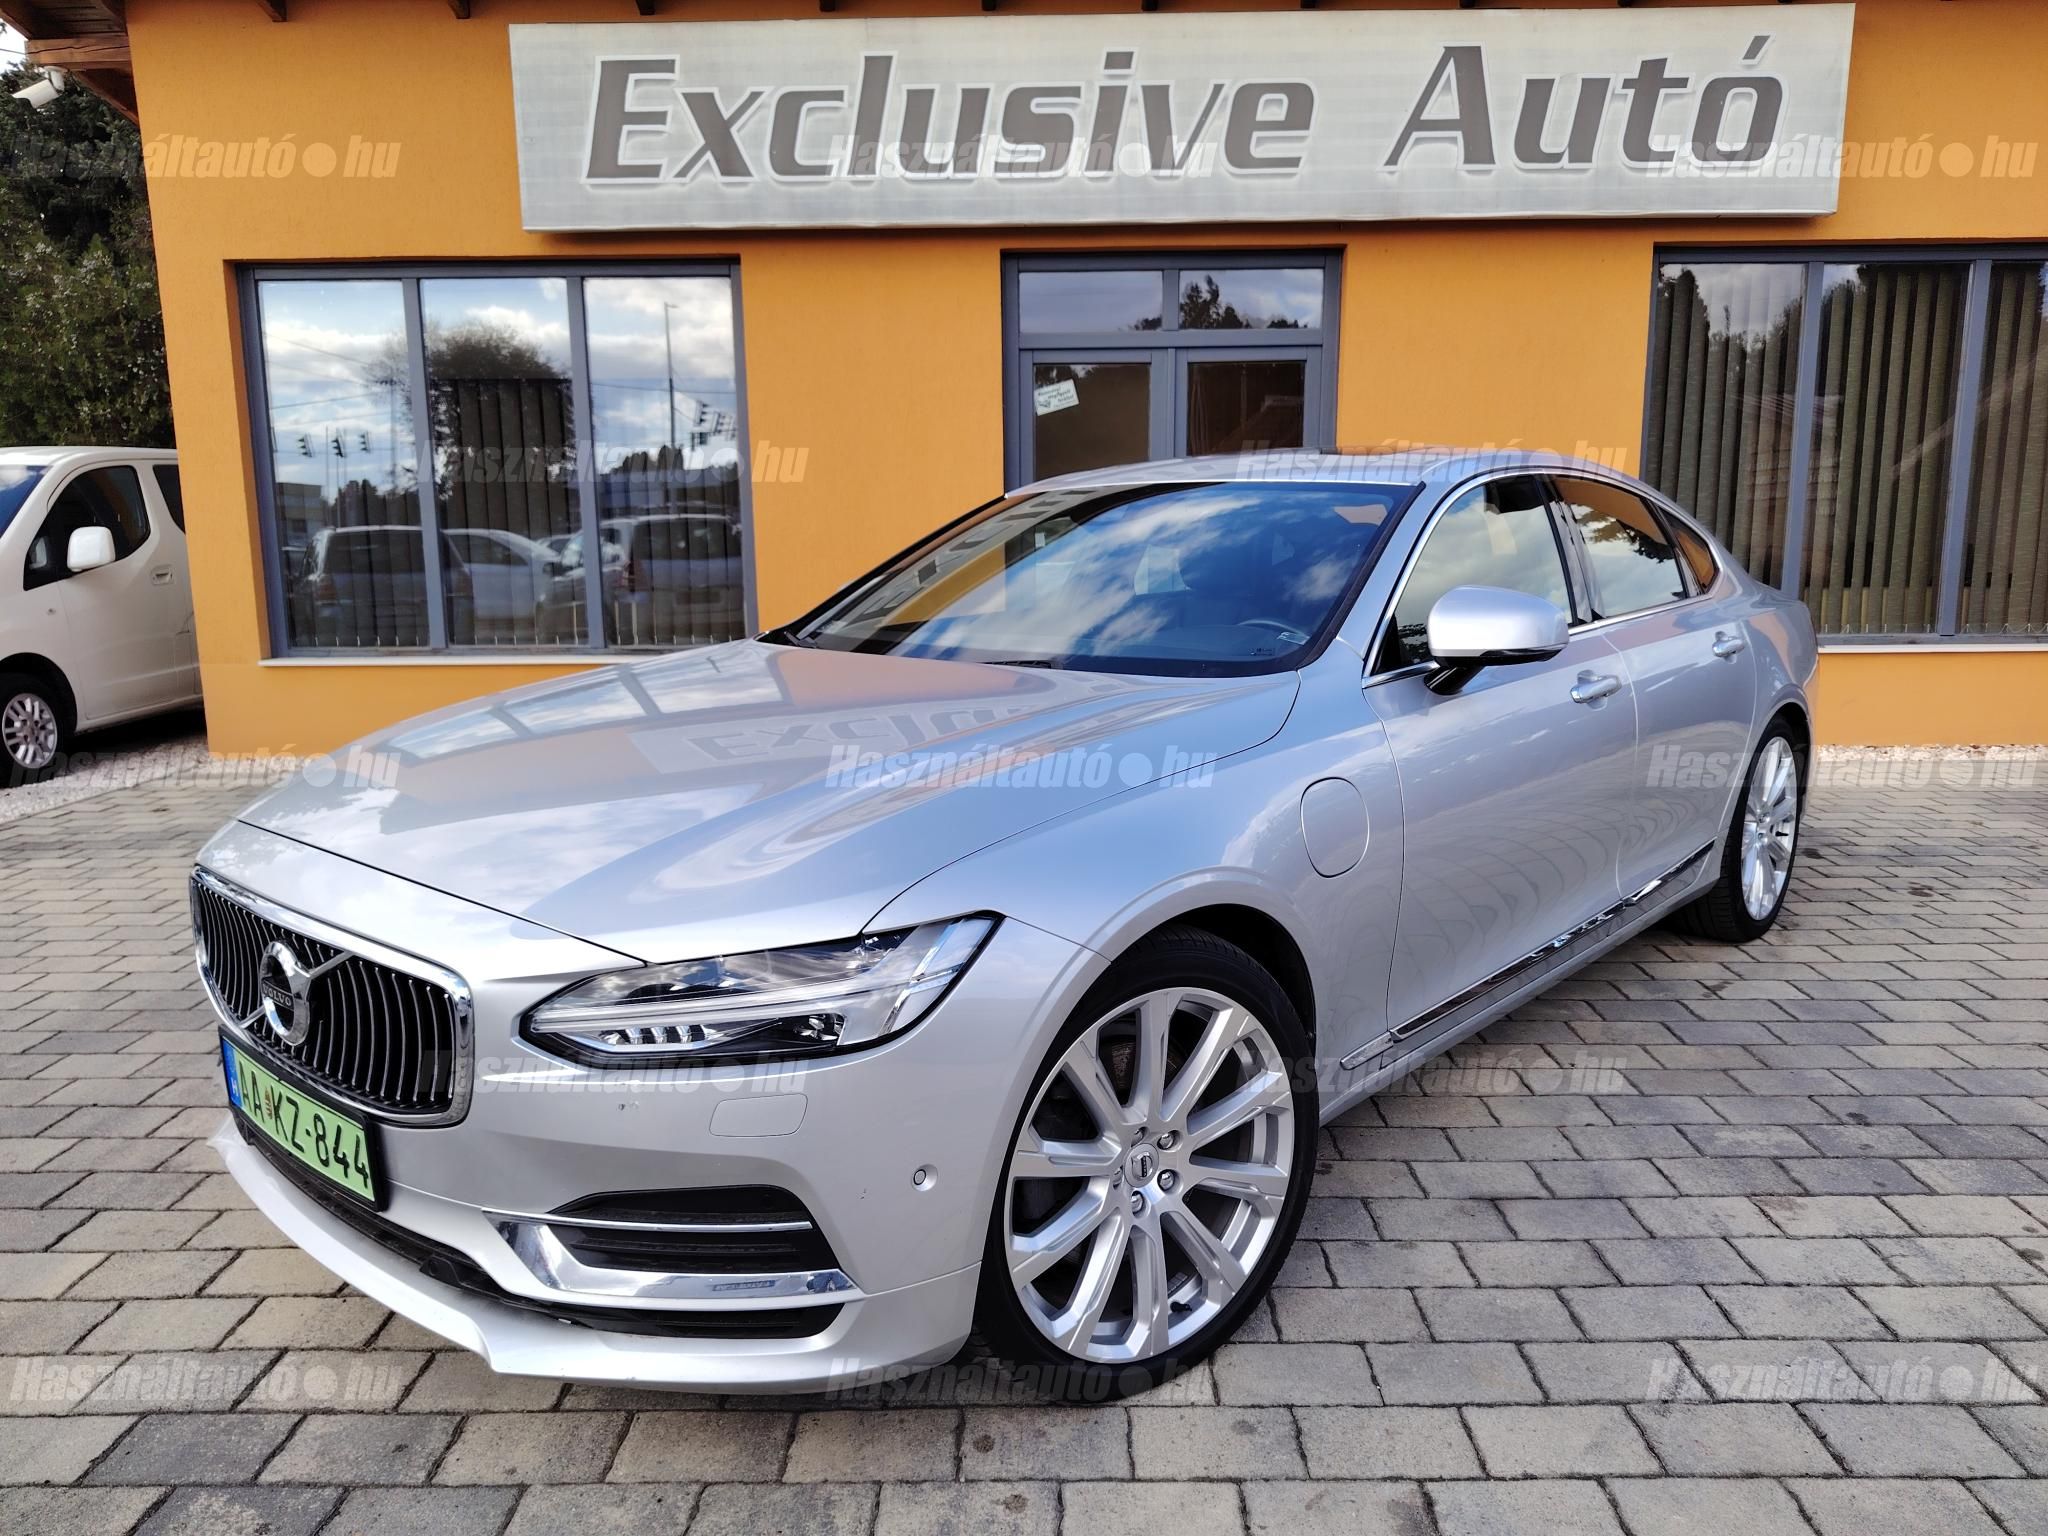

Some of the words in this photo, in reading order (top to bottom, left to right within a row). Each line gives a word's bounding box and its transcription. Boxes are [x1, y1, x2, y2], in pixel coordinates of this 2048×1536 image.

[583, 50, 1315, 182] Exclusive
[1383, 34, 1785, 168] Autó
[262, 983, 292, 1006] VOLVO
[271, 1085, 369, 1189] KZ-844
